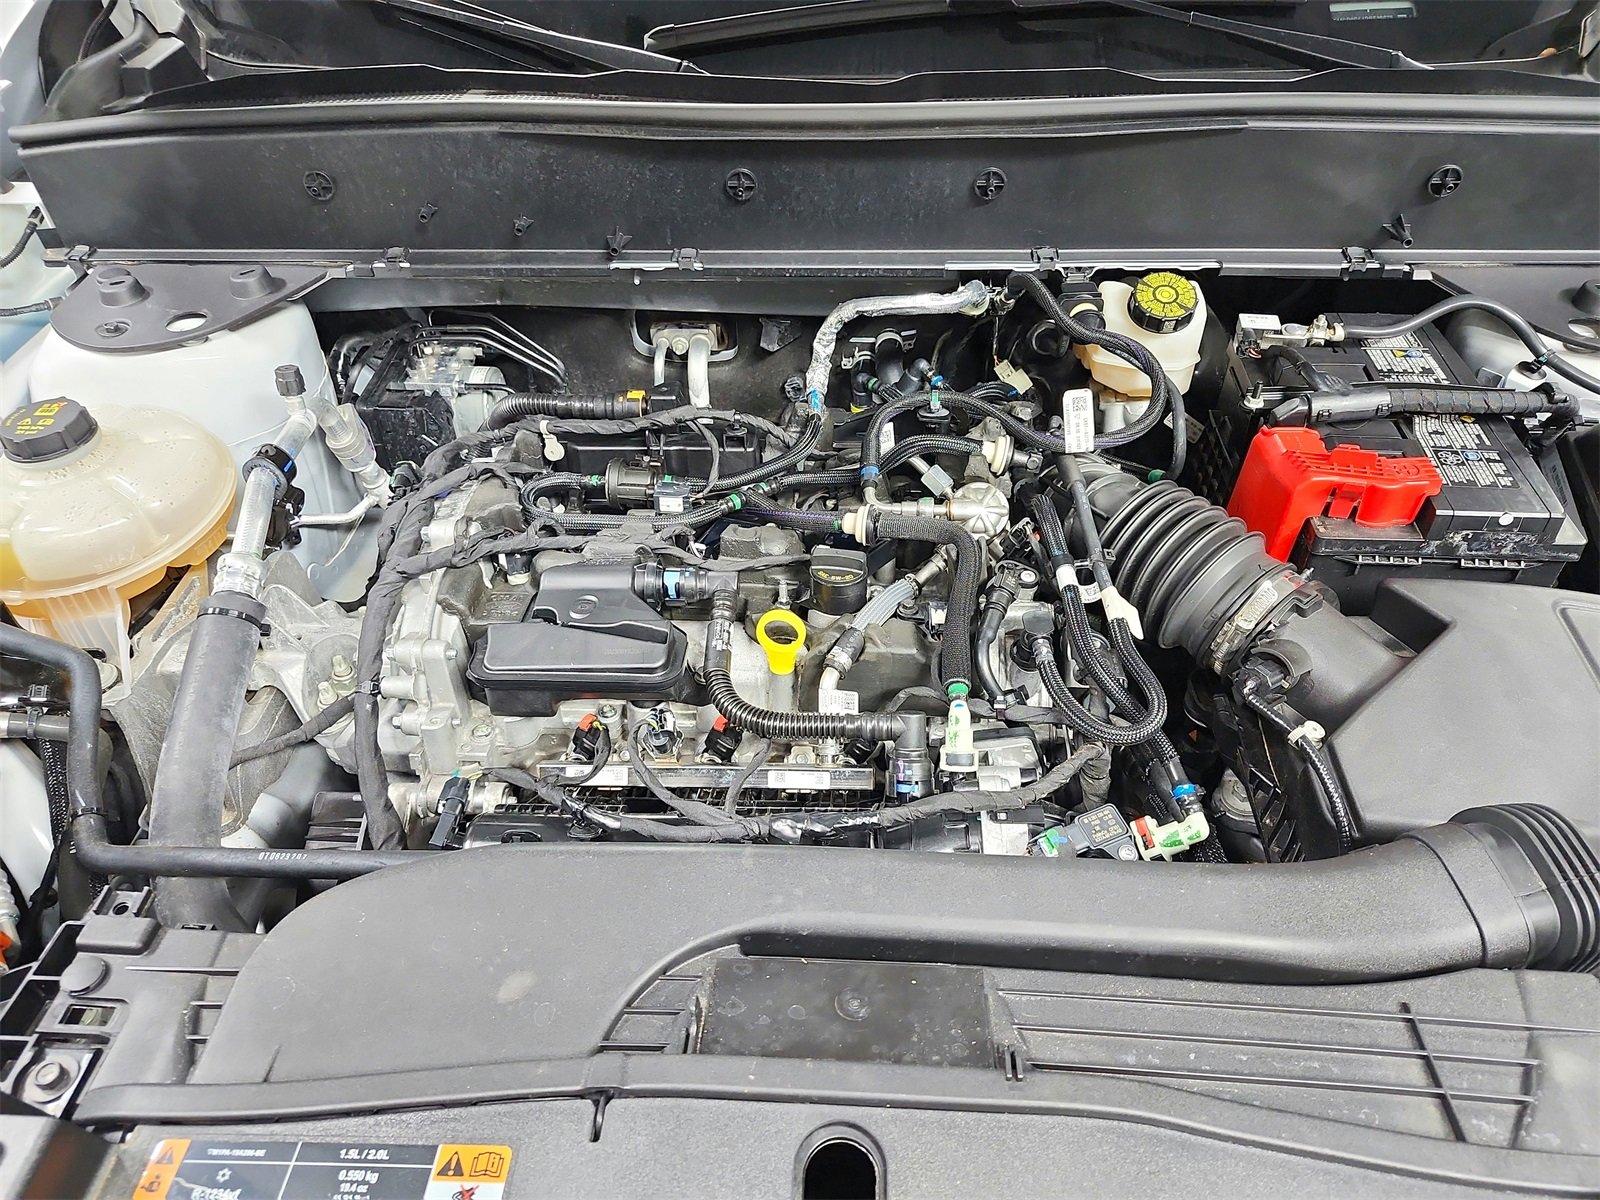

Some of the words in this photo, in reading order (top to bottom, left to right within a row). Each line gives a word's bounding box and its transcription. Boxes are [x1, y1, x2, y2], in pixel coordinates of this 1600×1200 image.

[340, 1149, 360, 1160] 1.5L
[367, 1149, 390, 1160] 2.0L
[338, 1169, 366, 1182] 0.550
[365, 1170, 379, 1184] kg
